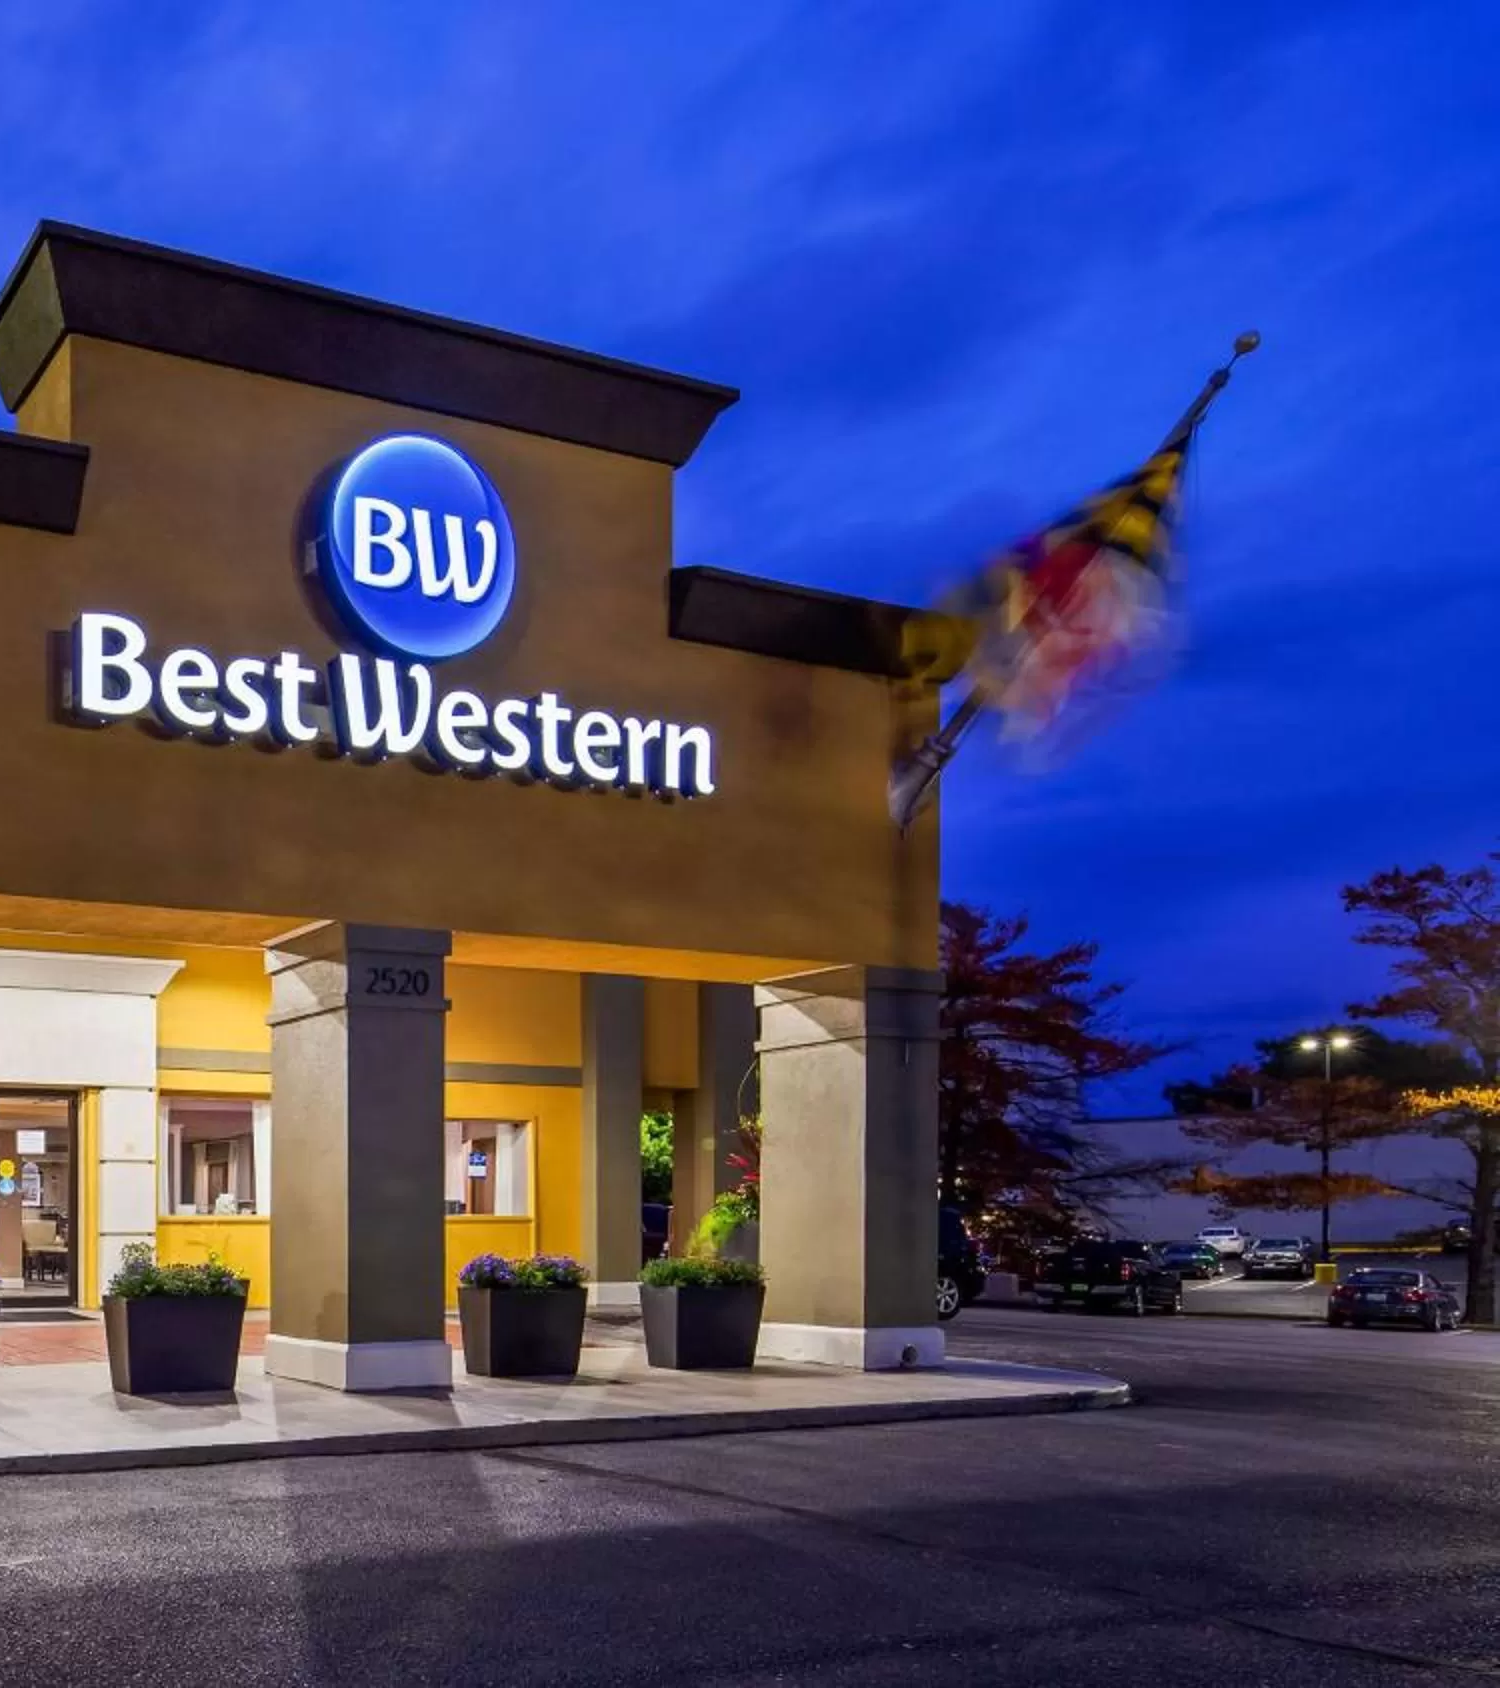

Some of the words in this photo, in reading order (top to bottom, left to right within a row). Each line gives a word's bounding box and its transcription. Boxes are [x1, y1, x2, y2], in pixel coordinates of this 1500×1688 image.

[354, 497, 497, 603] BW
[80, 612, 319, 742] Best
[339, 653, 714, 794] Western
[365, 967, 429, 996] 2520
